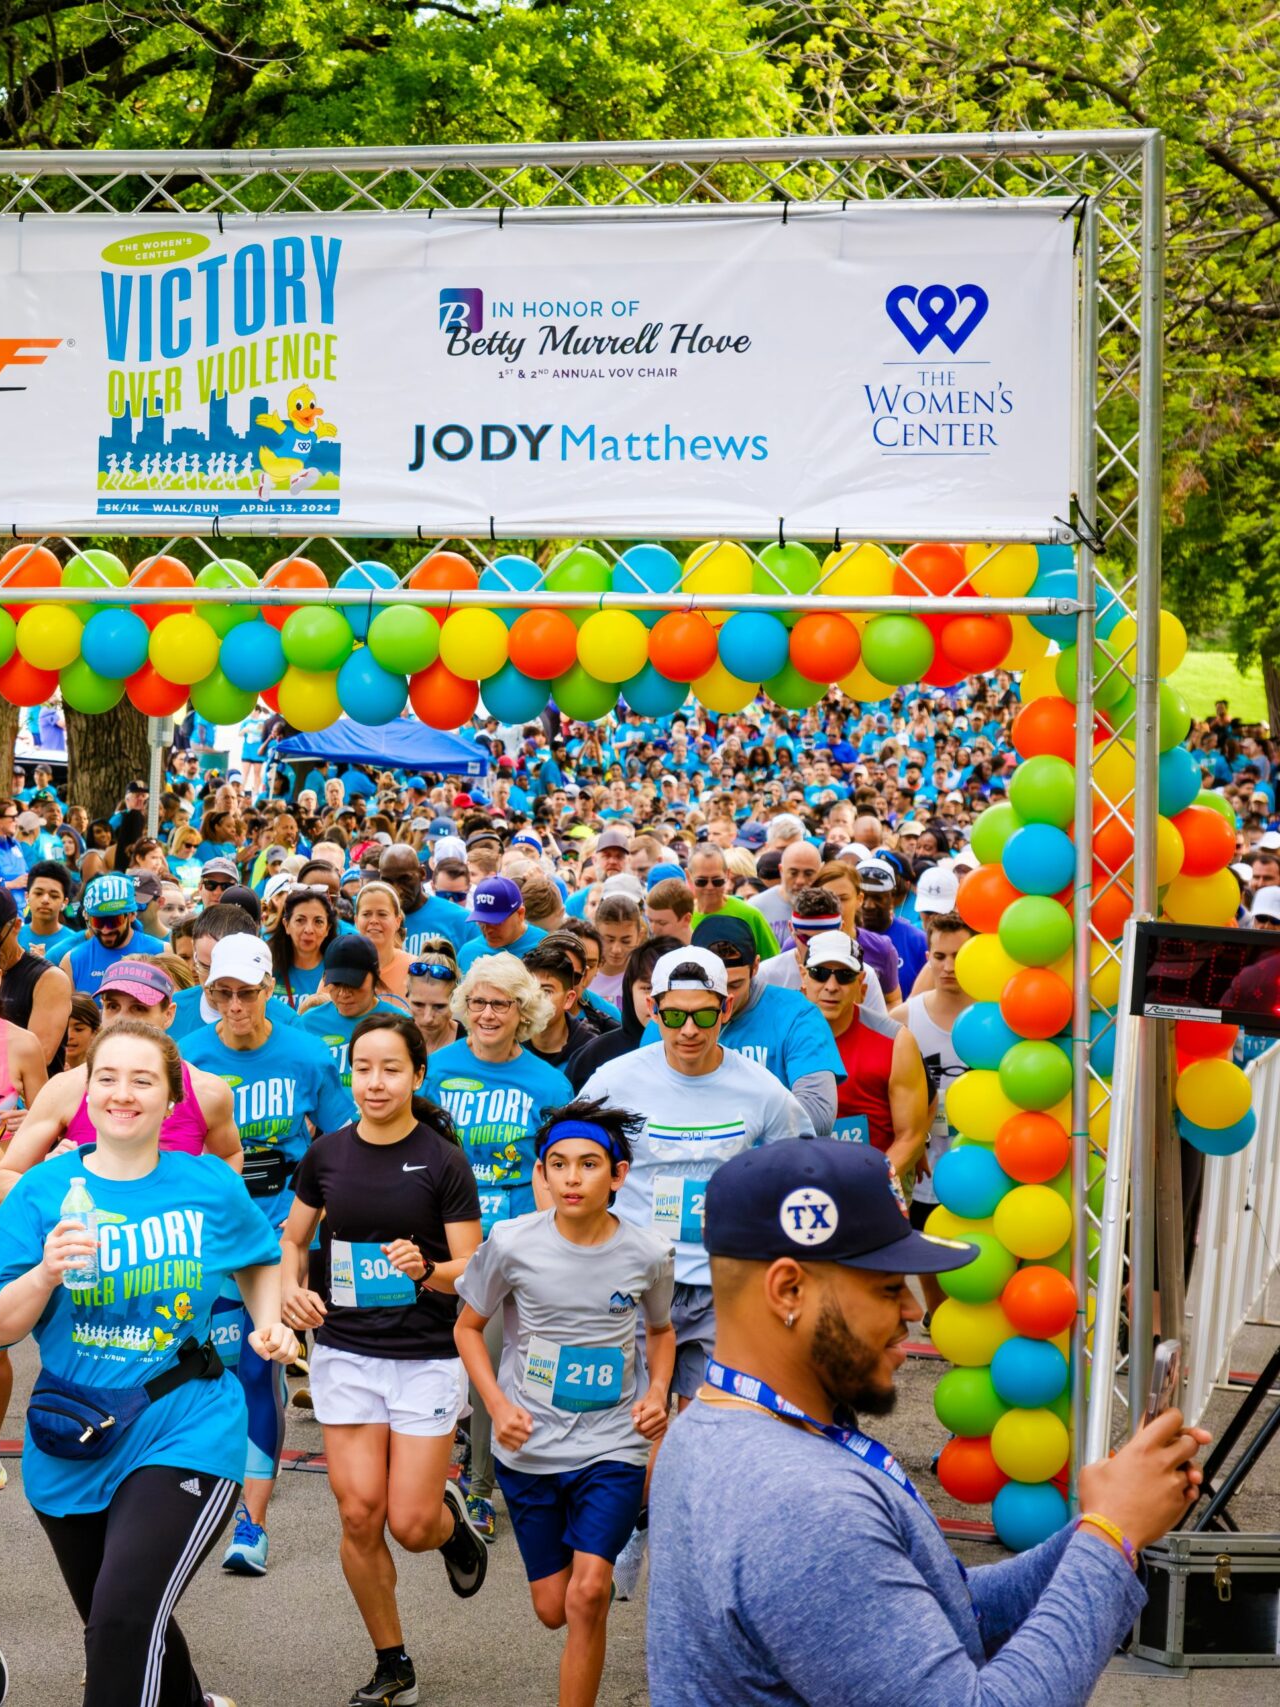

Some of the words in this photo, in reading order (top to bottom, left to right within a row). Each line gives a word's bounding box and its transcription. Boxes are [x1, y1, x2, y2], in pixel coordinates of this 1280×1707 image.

[118, 243, 139, 253] THE
[142, 237, 193, 250] WOMEN'S
[134, 249, 177, 261] CENTER
[100, 235, 342, 362] VICTORY
[492, 301, 513, 318] IN
[522, 301, 603, 318] HONOR
[611, 300, 640, 318] OF
[446, 325, 526, 364] Betty
[538, 322, 664, 356] Murrell
[669, 323, 752, 355] Hove
[107, 366, 182, 418] OVER
[196, 331, 338, 405] VIOLENCE
[517, 369, 526, 379] &
[552, 369, 605, 379] ANNUAL
[608, 368, 634, 378] VOV
[637, 367, 678, 378] CHAIR
[917, 371, 957, 387] THE
[408, 423, 554, 472] JODY
[560, 424, 769, 462] Matthews
[104, 503, 140, 513] 5K/1K
[152, 503, 219, 513] WALK/RUN
[240, 503, 276, 513] APRIL
[301, 503, 332, 513] 2024
[233, 1078, 297, 1125] TORY
[439, 1088, 534, 1127] VICTORY
[787, 1204, 832, 1230] TX
[123, 1259, 204, 1300] VIOLENCE
[529, 1357, 556, 1369] VICTORY
[564, 1363, 614, 1387] 218
